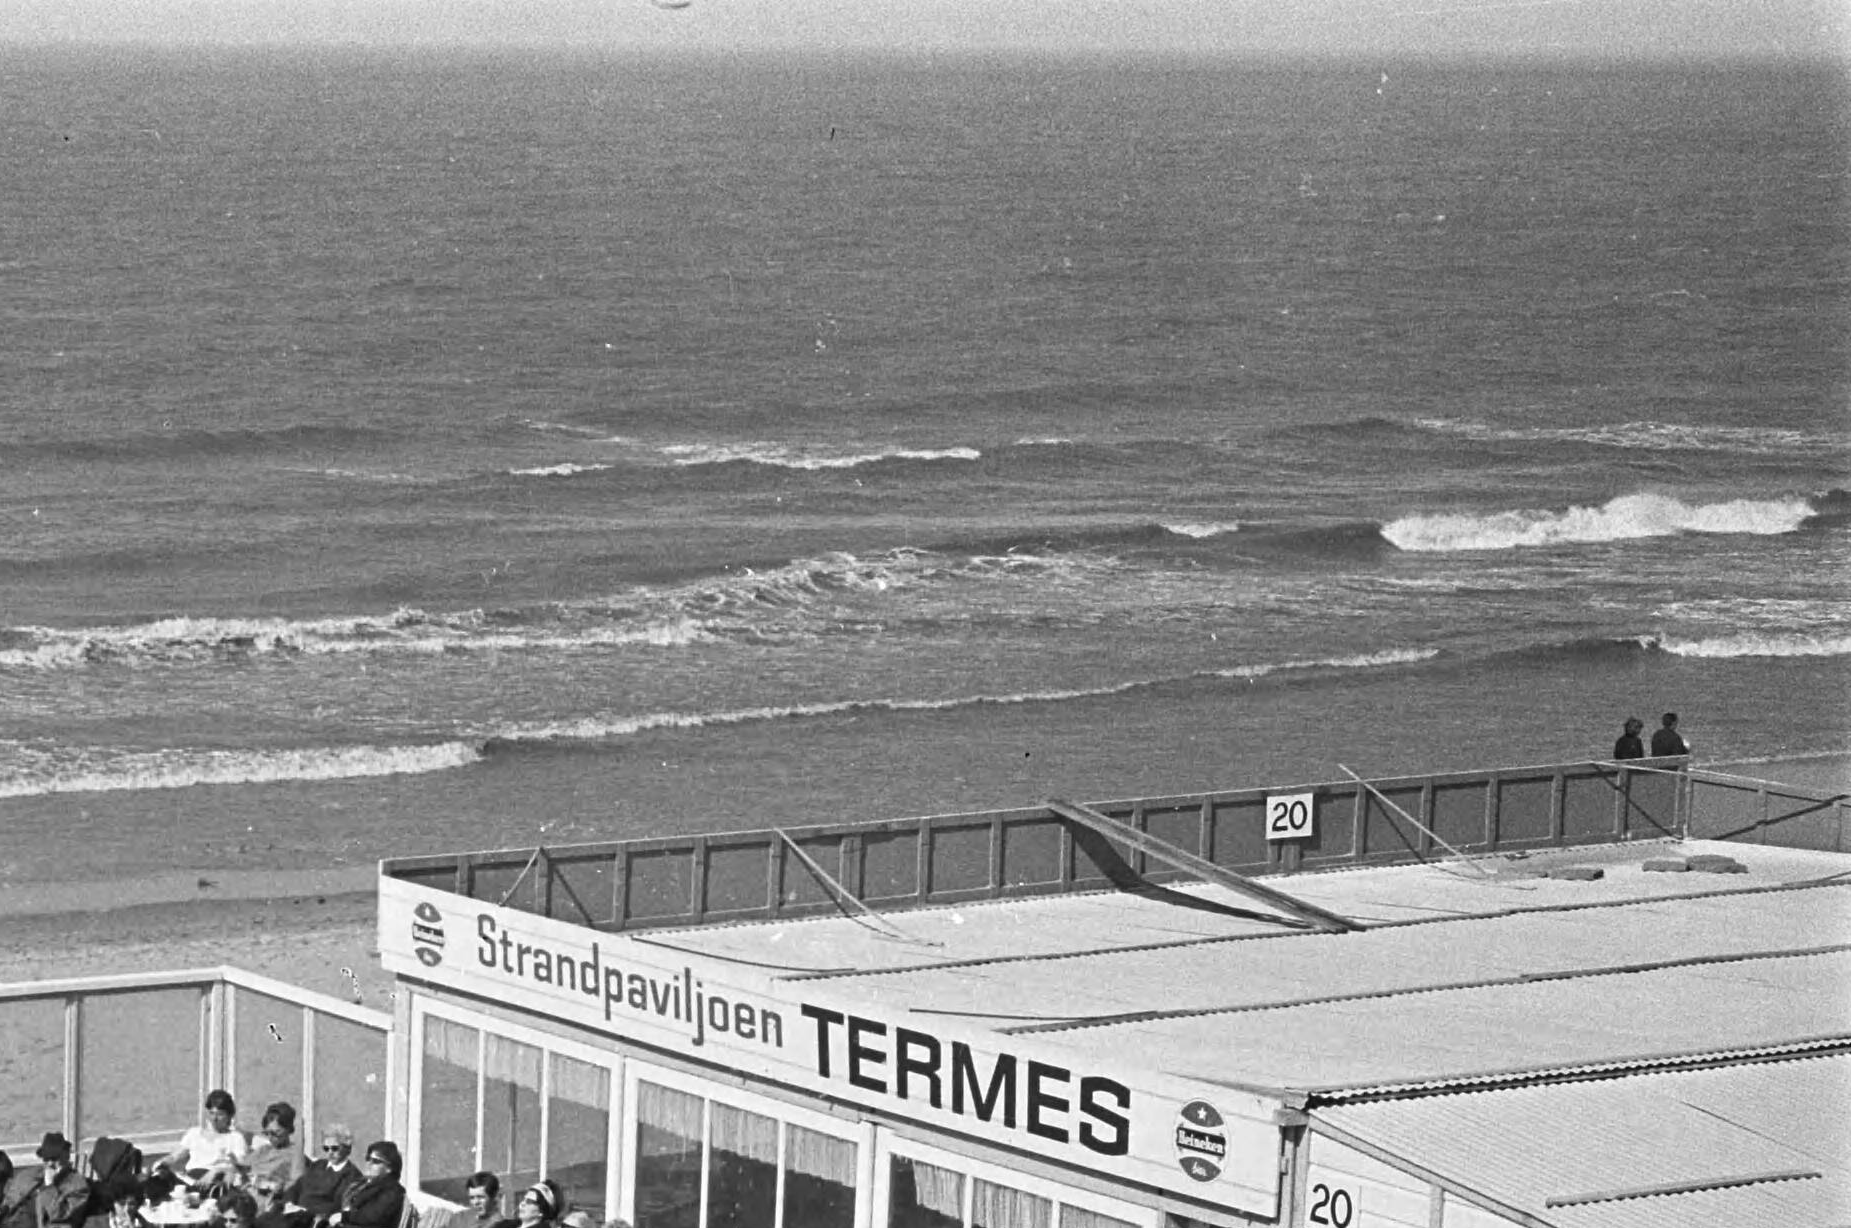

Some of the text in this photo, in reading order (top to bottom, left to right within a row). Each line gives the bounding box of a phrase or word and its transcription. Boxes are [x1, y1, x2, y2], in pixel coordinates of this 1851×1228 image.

[1271, 800, 1308, 832] 20
[476, 914, 1131, 1156] Strandpaviljoen TERMES
